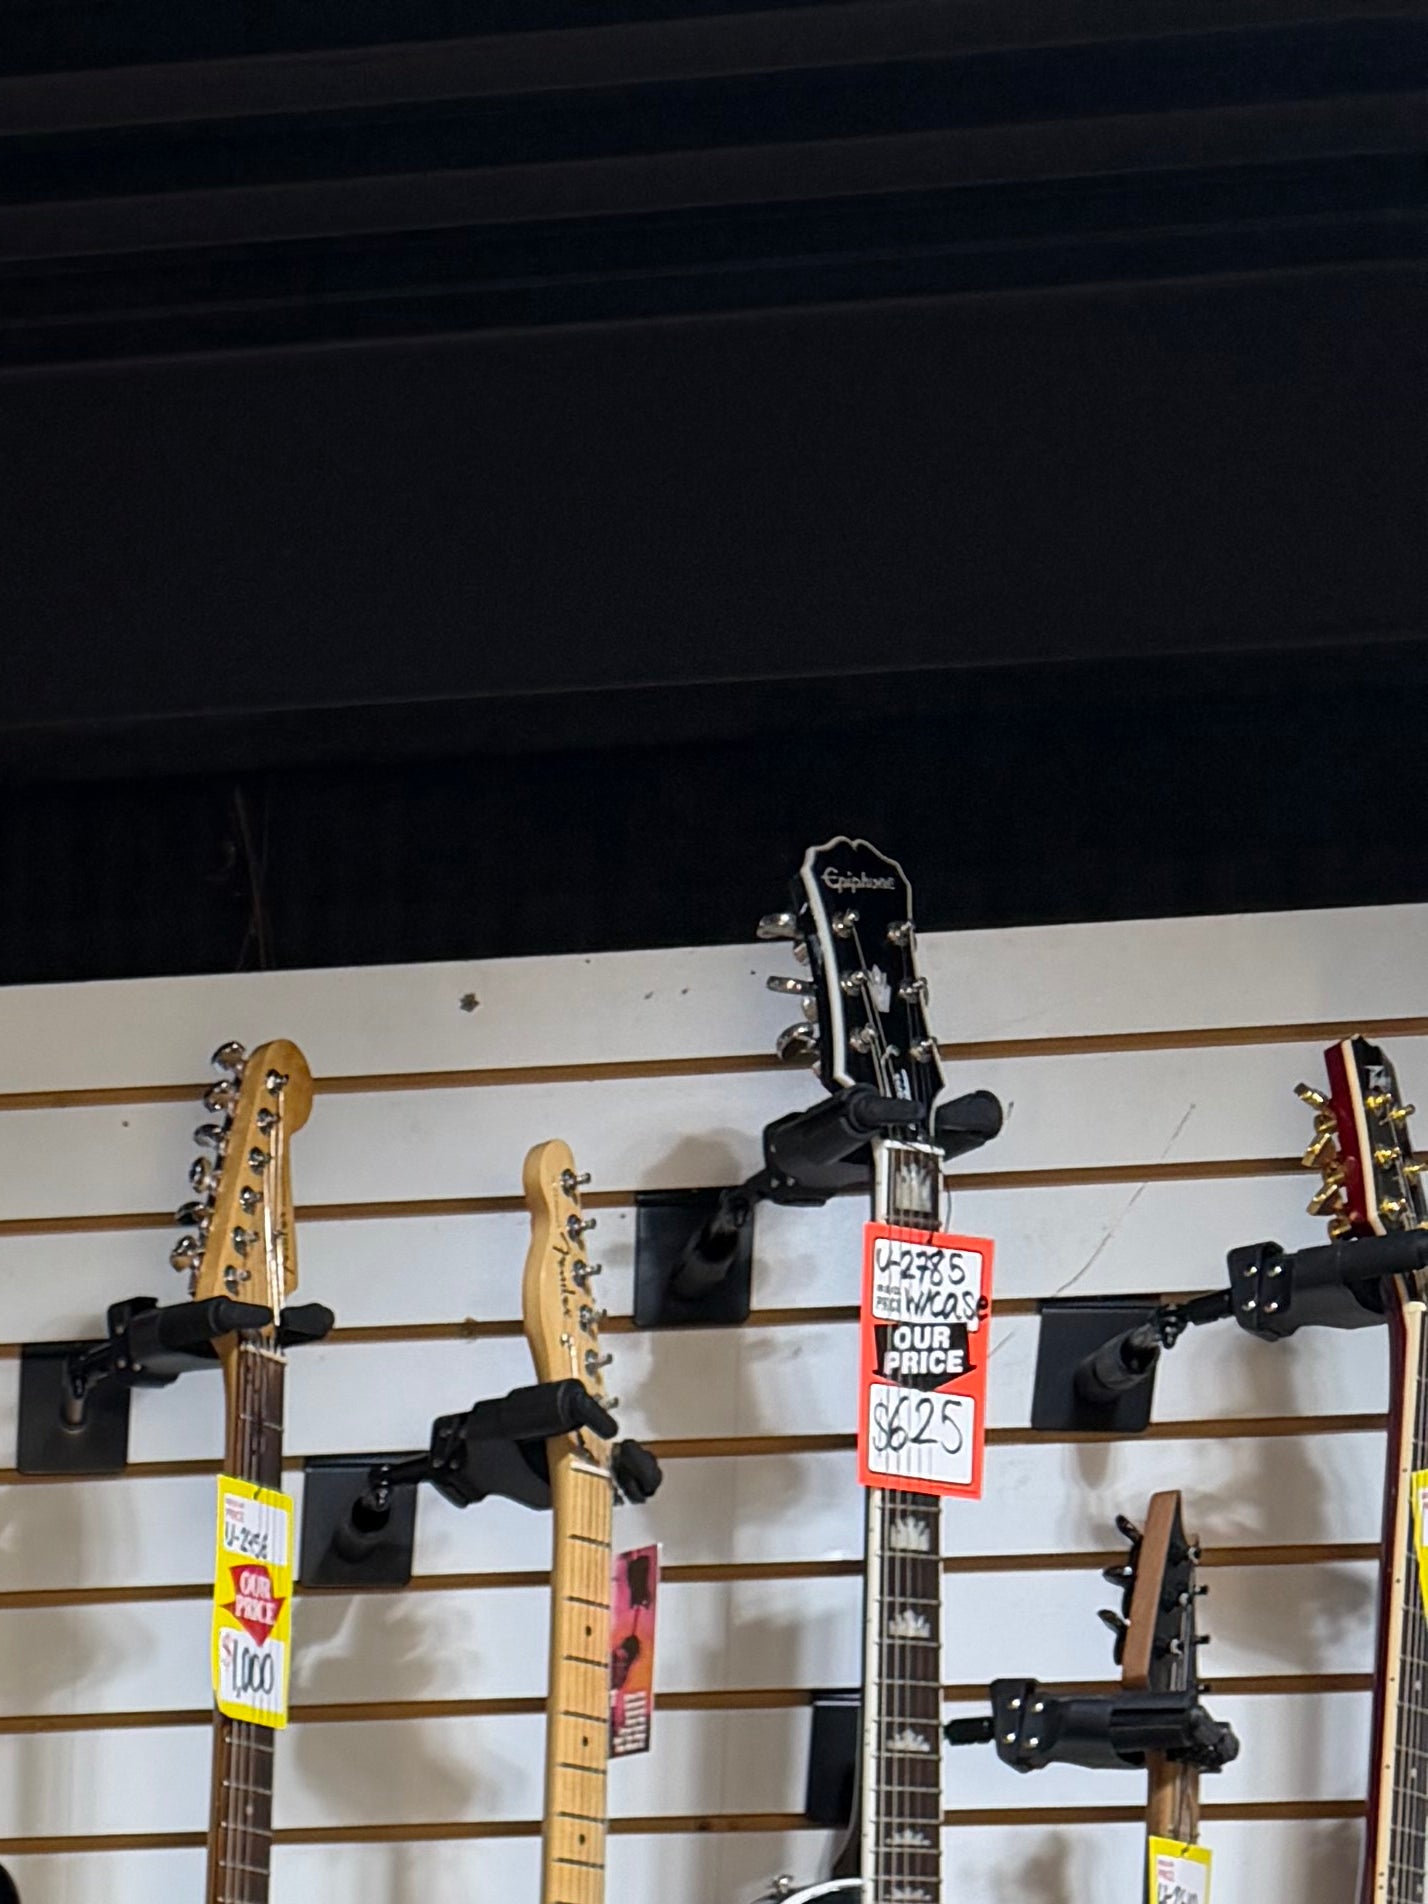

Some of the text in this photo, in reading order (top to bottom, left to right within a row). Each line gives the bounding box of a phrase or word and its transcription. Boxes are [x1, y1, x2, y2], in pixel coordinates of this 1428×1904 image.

[821, 867, 895, 894] Epiphone
[875, 1246, 966, 1286] U-2785
[894, 1325, 950, 1350] OUR
[883, 1349, 964, 1375] PRICE
[872, 1396, 963, 1455] $625
[239, 1570, 273, 1598] OUR
[235, 1596, 277, 1626] PRICE
[221, 1633, 275, 1699] $1,000
